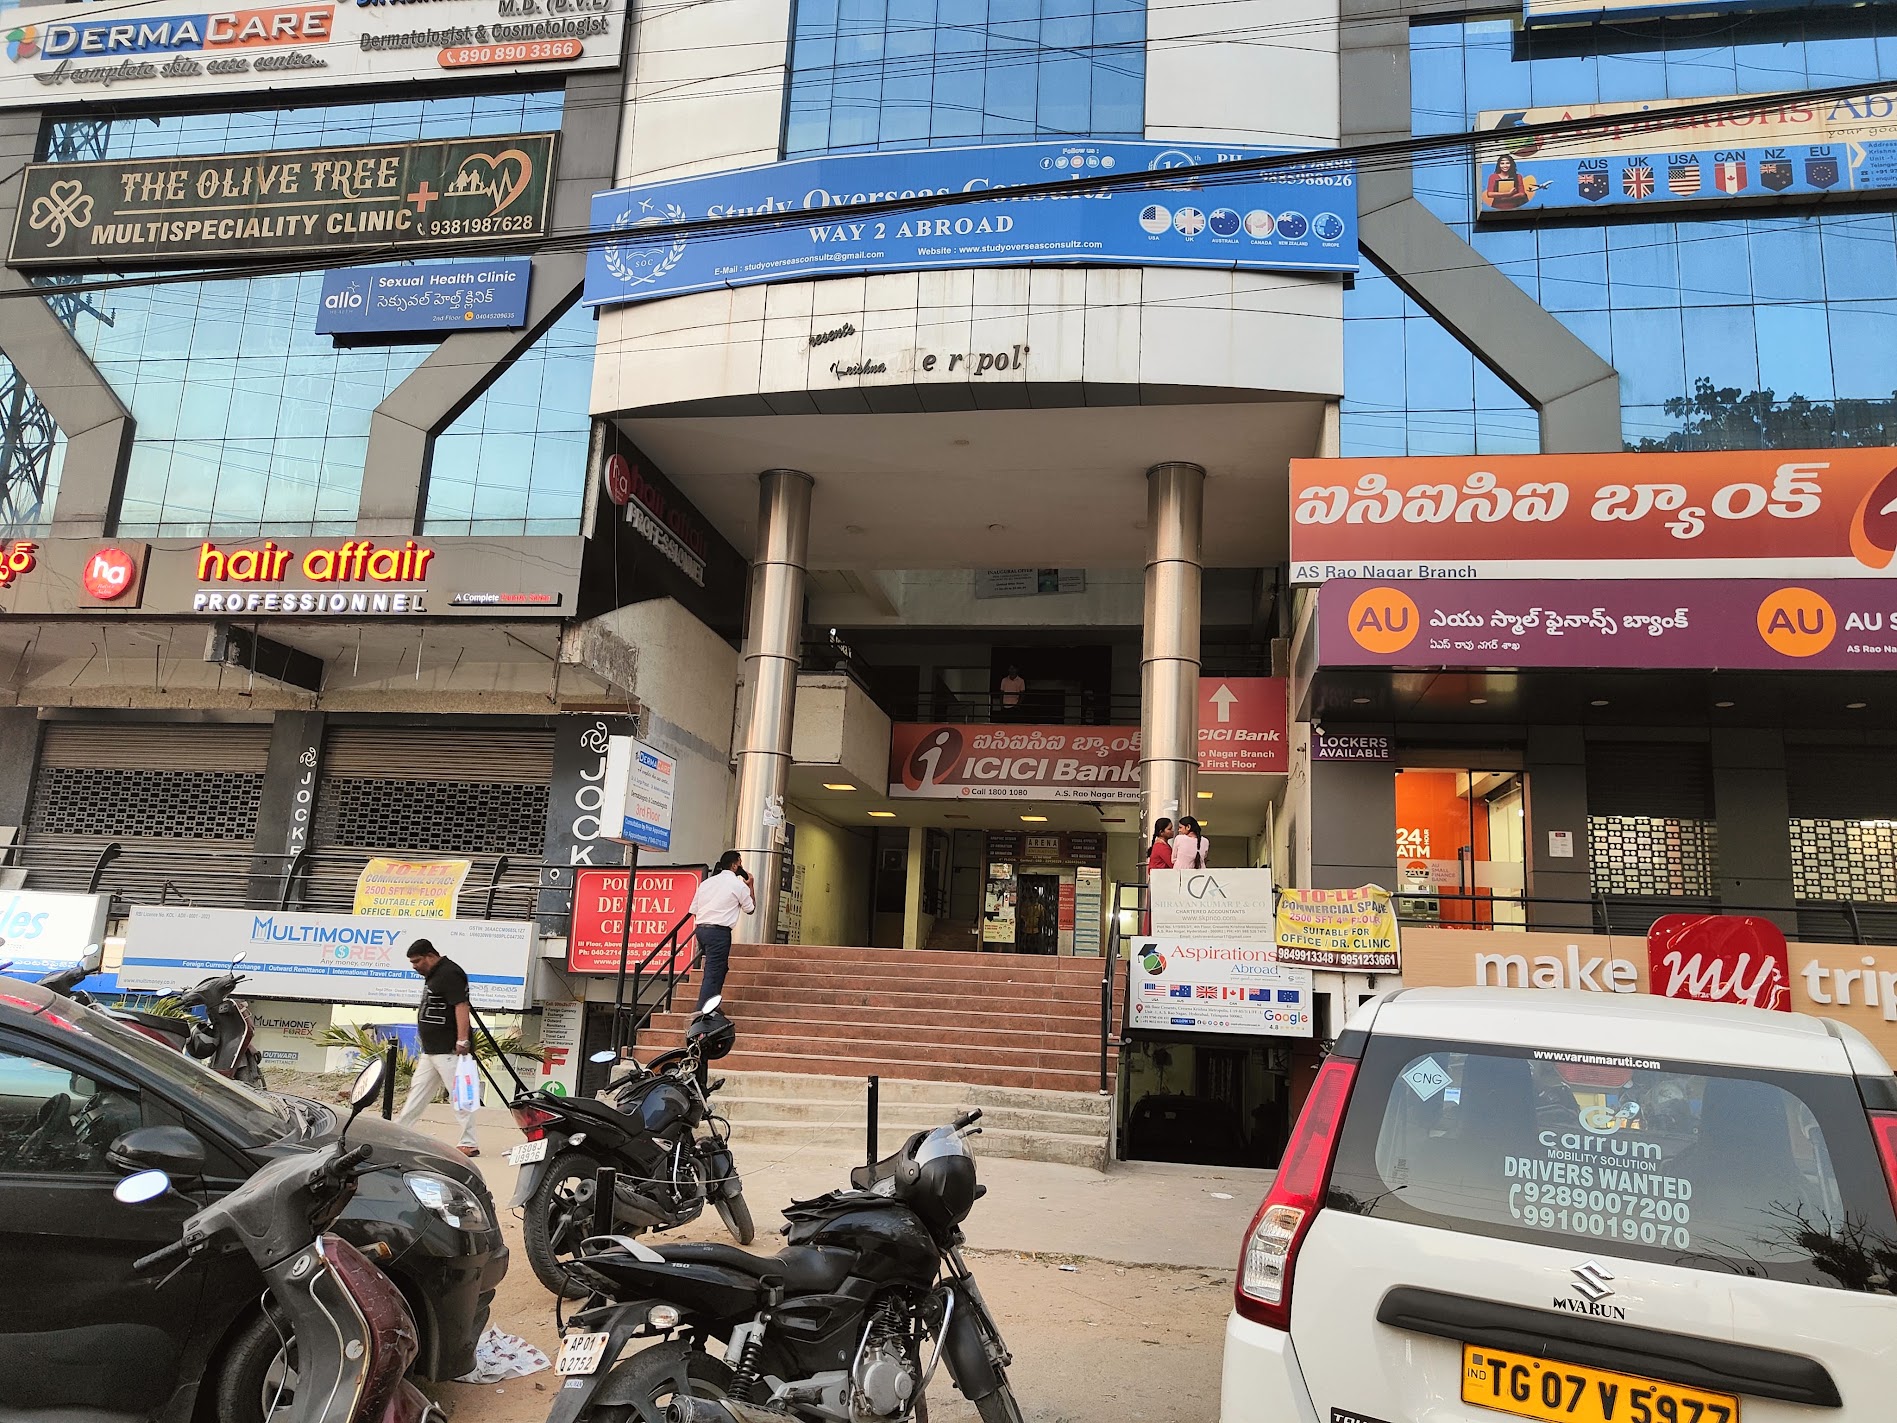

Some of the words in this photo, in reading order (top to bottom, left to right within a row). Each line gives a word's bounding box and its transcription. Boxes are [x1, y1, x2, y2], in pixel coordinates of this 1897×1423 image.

[360, 25, 471, 51] Dermatologist
[475, 24, 490, 42] &
[492, 15, 610, 40] Cosmetologist
[459, 48, 491, 63] 890
[494, 45, 527, 61] 890
[530, 41, 574, 59] 3366
[34, 59, 72, 86] A
[70, 57, 156, 87] complete
[160, 54, 203, 79] skin
[206, 57, 249, 75] care
[1578, 158, 1608, 171] AUS
[1627, 157, 1649, 169] UK
[1667, 154, 1700, 166] USA
[1713, 150, 1746, 163] CAN
[1764, 148, 1786, 160] NZ
[1809, 146, 1831, 157] EU
[120, 170, 190, 202] THE
[195, 163, 301, 200] OLIVE
[310, 157, 401, 200] TREE
[91, 212, 321, 247] MULTISPECIALITY
[326, 208, 414, 235] CLINIC
[430, 214, 534, 236] 9381987628
[808, 223, 867, 244] WAY
[873, 225, 887, 240] 2
[895, 216, 1014, 240] ABROAD
[713, 263, 739, 276] E-Mail
[744, 250, 885, 273] studyoverseasconsultz@gmail.com
[917, 245, 951, 257] Website
[959, 241, 1103, 254] www.studyoverseasconsultz.com
[378, 275, 424, 288] Sexual
[430, 273, 475, 286] Health
[477, 271, 517, 285] Clinic
[325, 291, 363, 309] allo
[432, 315, 445, 323] 2nd
[1590, 462, 1831, 540] బ్యాంక్
[93, 556, 126, 584] ha
[196, 541, 294, 583] hair
[302, 540, 435, 583] affair
[1296, 565, 1320, 579] AS
[1325, 565, 1357, 579] Rao
[1362, 565, 1413, 579] Nagar
[1418, 564, 1478, 579] Branch
[193, 593, 428, 613] PROFESSIONNEL
[454, 593, 462, 601] A
[463, 593, 500, 604] Complete
[1356, 606, 1409, 633] AU
[1767, 607, 1824, 635] AU
[1844, 612, 1883, 631] AU
[1846, 645, 1860, 653] AS
[1863, 644, 1882, 653] Rao
[1234, 730, 1280, 741] Bank
[1319, 737, 1388, 748] LOCKERS
[1208, 749, 1239, 759] Nagar
[1240, 749, 1275, 759] Branch
[1318, 748, 1389, 758] AVAILABLE
[961, 757, 1050, 780] ICICI
[1052, 758, 1142, 782] Bank
[1206, 760, 1229, 769] First
[1231, 760, 1257, 769] Floor
[988, 788, 1007, 796] 1800
[1009, 788, 1028, 796] 1080
[1055, 790, 1071, 798] A.S.
[1073, 790, 1089, 798] Rao
[1090, 790, 1116, 800] Nagar
[636, 803, 646, 818] 3rd
[1028, 839, 1058, 847] ARENA
[1395, 827, 1423, 845] 24
[1396, 844, 1431, 859] ATM
[386, 863, 453, 877] TO-LET
[364, 886, 386, 895] 2500
[388, 886, 405, 896] SFT
[602, 877, 674, 891] POULOMI
[373, 898, 416, 907] SUITABLE
[418, 899, 435, 907] FOR
[1297, 886, 1372, 903] TO-LET
[360, 907, 391, 917] OFFICE
[398, 908, 413, 917] DR.
[415, 909, 445, 917] CLINIC
[1281, 899, 1355, 914] COMMERCIAL
[1289, 912, 1312, 923] 2500
[1315, 915, 1333, 924] SFT
[251, 915, 402, 945] MULTIMONEY
[1303, 926, 1349, 936] SUITABLE
[1351, 927, 1370, 936] FOR
[1281, 933, 1322, 947] OFFICE
[1331, 938, 1350, 948] DR.
[1353, 939, 1391, 948] CLINIC
[1170, 945, 1278, 963] Aspirations
[1278, 948, 1333, 964] 9849913348
[1340, 954, 1396, 966] 9951233661
[182, 960, 205, 969] Foreign
[205, 962, 232, 970] Currency
[232, 963, 261, 972] Exchange
[268, 965, 293, 973] Outward
[293, 966, 326, 974] Remittance
[332, 968, 369, 976] International
[369, 970, 388, 978] Travel
[388, 970, 402, 978] Card
[319, 958, 334, 966] Any
[335, 960, 360, 968] money,
[1230, 963, 1279, 975] Abroad
[1475, 944, 1638, 993] make
[1662, 950, 1777, 1007] my
[253, 1015, 317, 1029] MULTIMONEY
[1263, 1009, 1309, 1025] Google
[263, 1051, 298, 1059] OUTWARD
[1533, 1050, 1661, 1070] www.varunmaruti.com
[1412, 1072, 1443, 1085] CNG
[1538, 1129, 1663, 1161] carrum
[1547, 1150, 1598, 1165] MOBILITY
[1600, 1156, 1657, 1172] SOLUTION
[1504, 1156, 1594, 1188] DRIVERS
[1598, 1167, 1692, 1201] WANTED
[1523, 1180, 1690, 1224] 9289007200
[1523, 1204, 1690, 1249] 9910019070
[570, 1336, 584, 1351] AP
[584, 1336, 596, 1351] 01
[567, 1357, 593, 1372] 2752
[1467, 1369, 1488, 1381] IND
[1486, 1358, 1531, 1402] TG
[1542, 1374, 1587, 1413] 07
[1597, 1381, 1619, 1420] V
[1630, 1388, 1732, 1423] 5977
